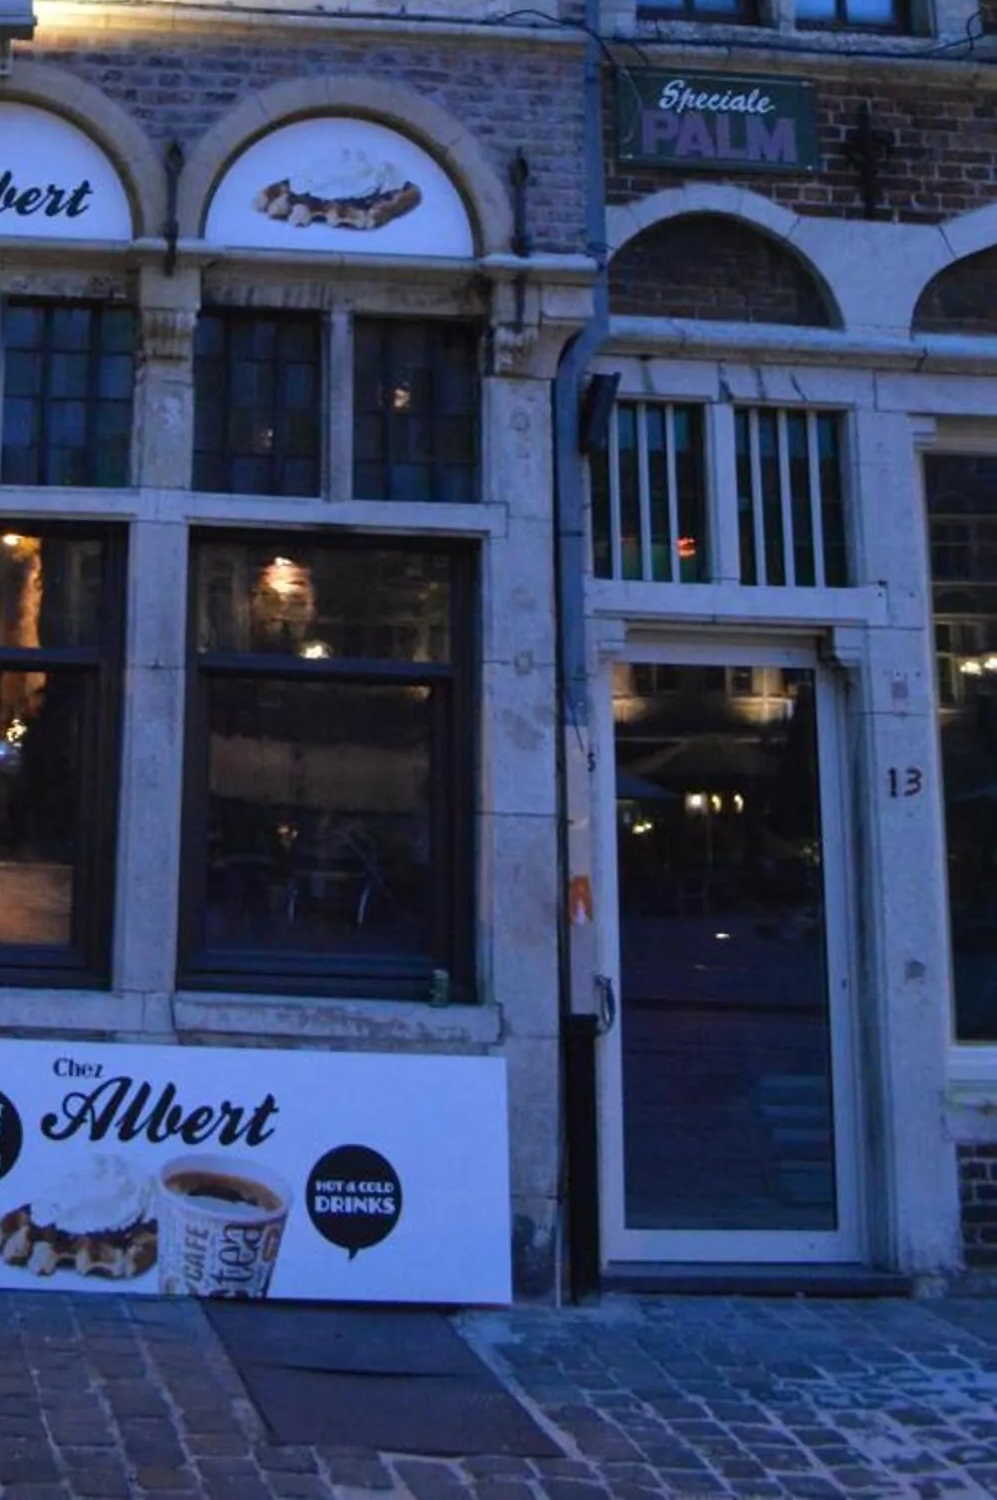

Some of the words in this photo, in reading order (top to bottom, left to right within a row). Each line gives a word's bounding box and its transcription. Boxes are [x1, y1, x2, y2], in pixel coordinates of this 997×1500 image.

[659, 79, 776, 114] Speciale
[642, 109, 797, 163] PALM
[888, 766, 922, 798] 13
[53, 1057, 104, 1079] Chez
[40, 1076, 280, 1147] Albert
[316, 1180, 343, 1192] HOT
[358, 1181, 394, 1194] COLD
[314, 1195, 396, 1215] DRINKS
